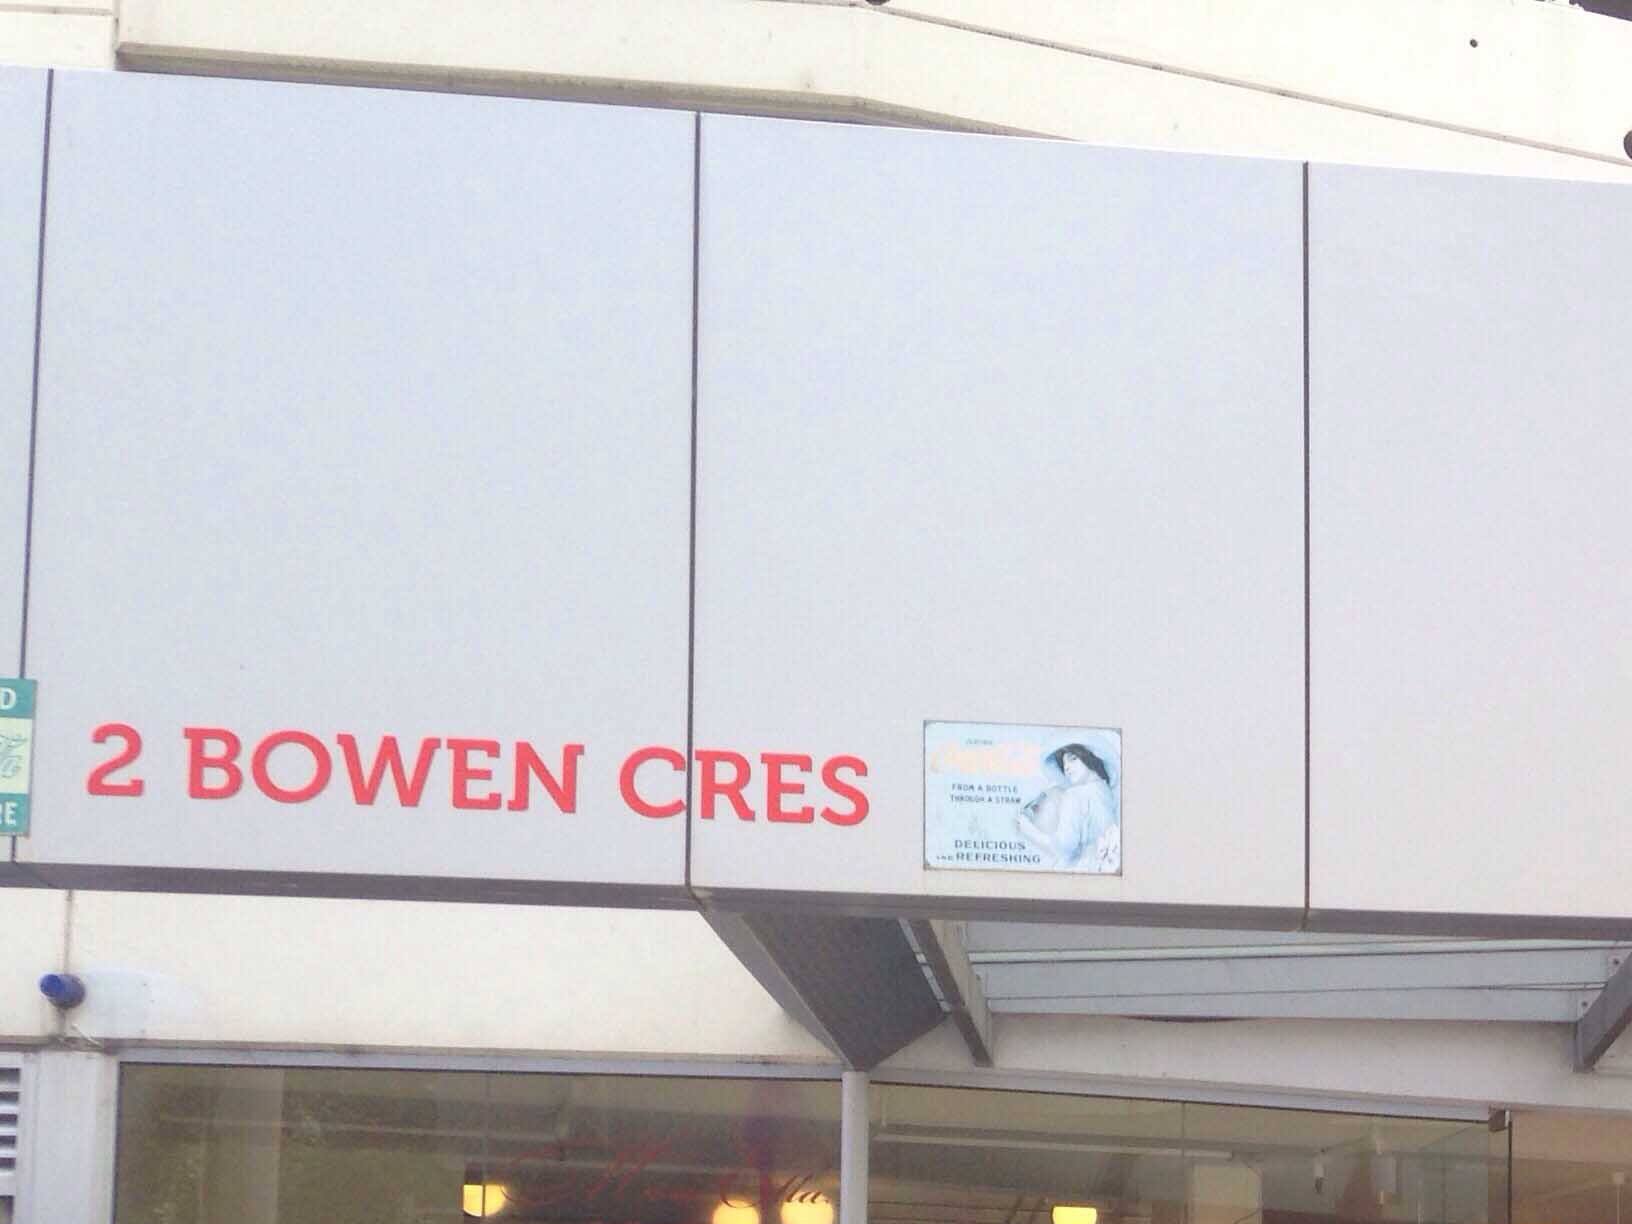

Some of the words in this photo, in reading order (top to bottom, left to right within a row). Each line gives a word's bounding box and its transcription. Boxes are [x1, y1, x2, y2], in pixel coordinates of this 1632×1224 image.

[85, 721, 146, 797] 2
[181, 725, 586, 815] BOWEN
[617, 744, 871, 828] CRES
[951, 783, 975, 792] FROM
[986, 785, 1018, 793] BOTTLE
[950, 794, 985, 803] THROUGH
[995, 796, 1022, 804] STRAW
[954, 839, 1026, 850] DELICIOUS
[955, 852, 1041, 864] REFRESHING
